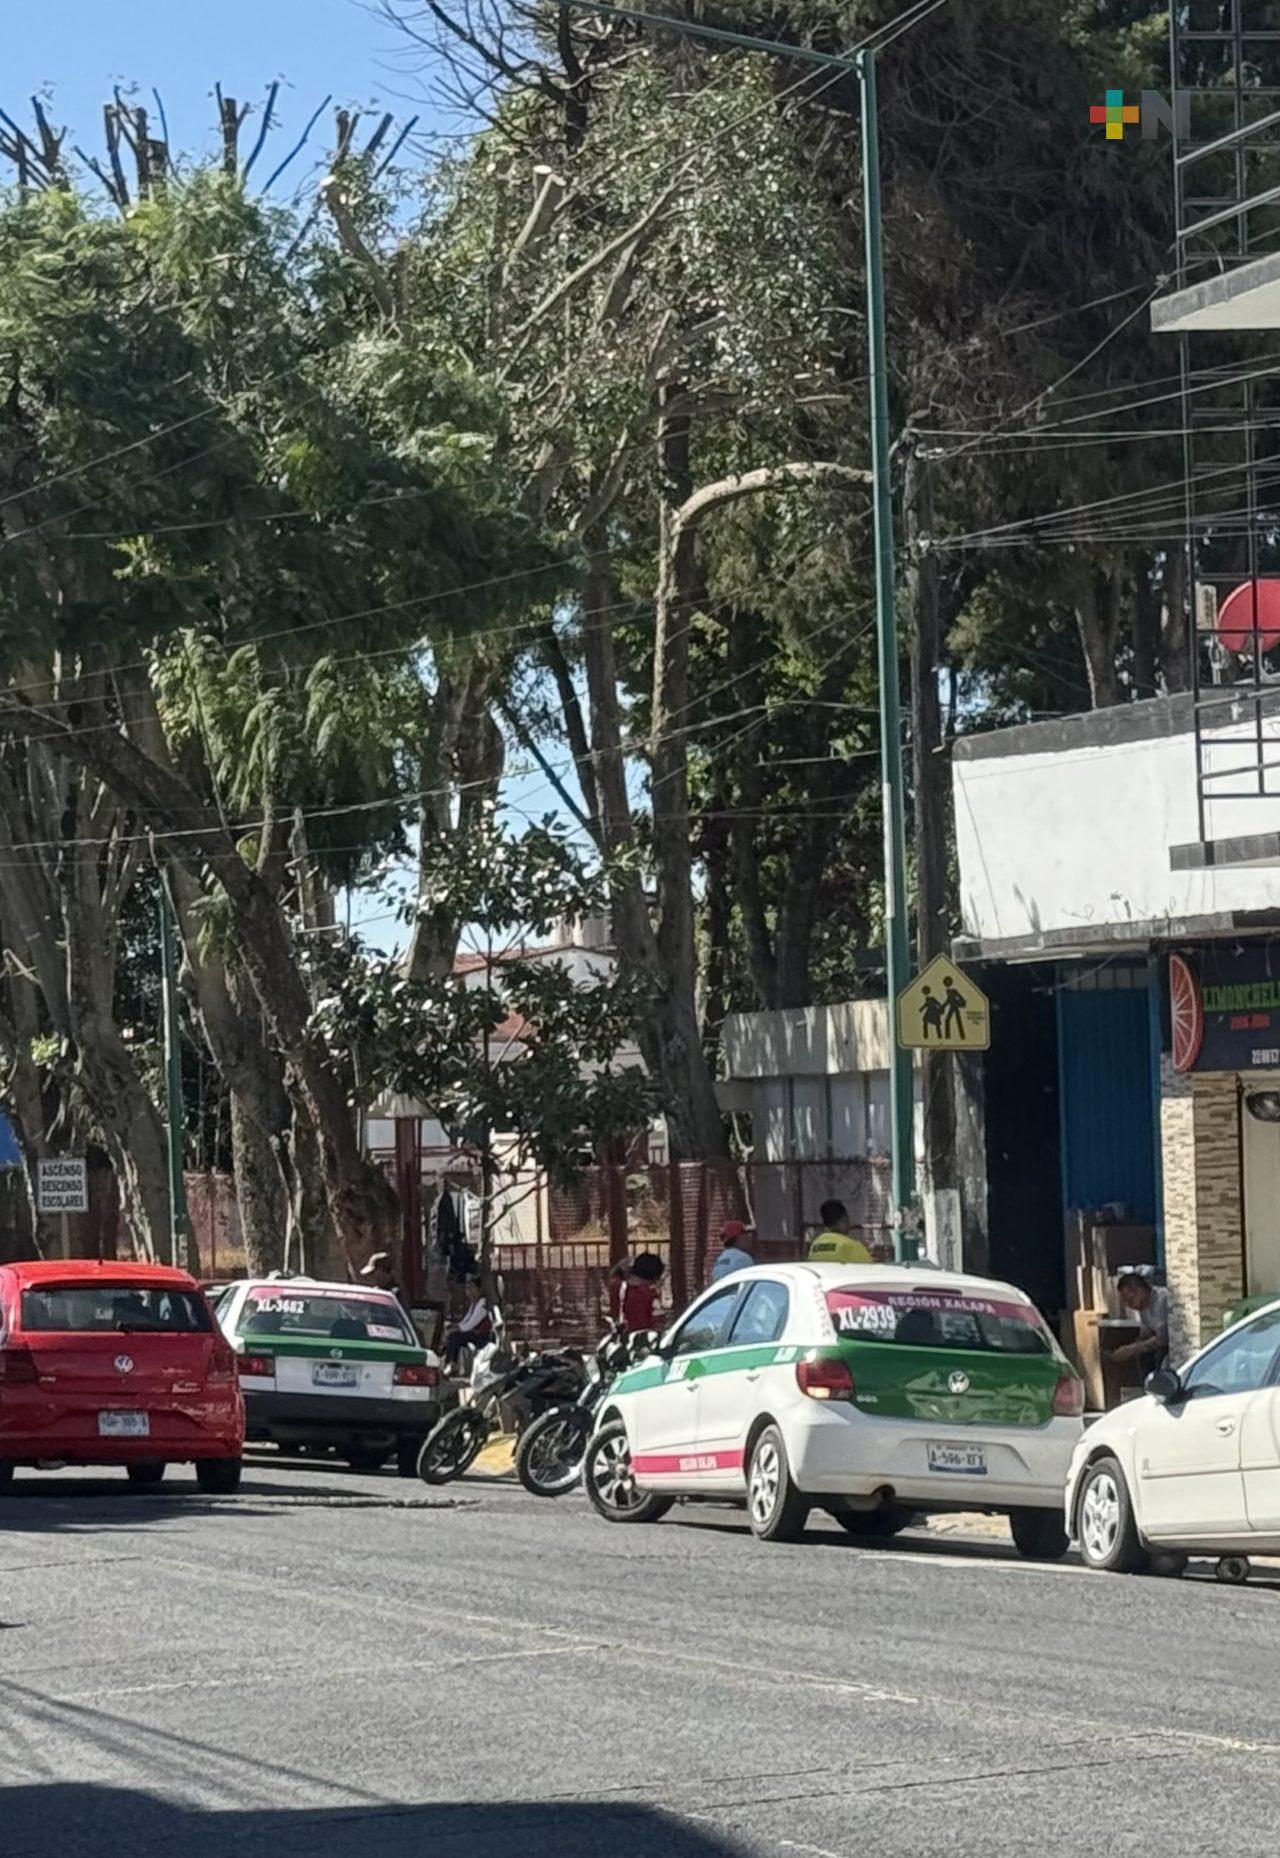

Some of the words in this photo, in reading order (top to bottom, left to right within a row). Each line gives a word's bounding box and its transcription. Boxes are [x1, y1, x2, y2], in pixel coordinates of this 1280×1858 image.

[41, 1195, 83, 1208] ESCOLARES
[944, 1298, 996, 1315] XALAPA
[836, 1305, 897, 1331] XL-2939
